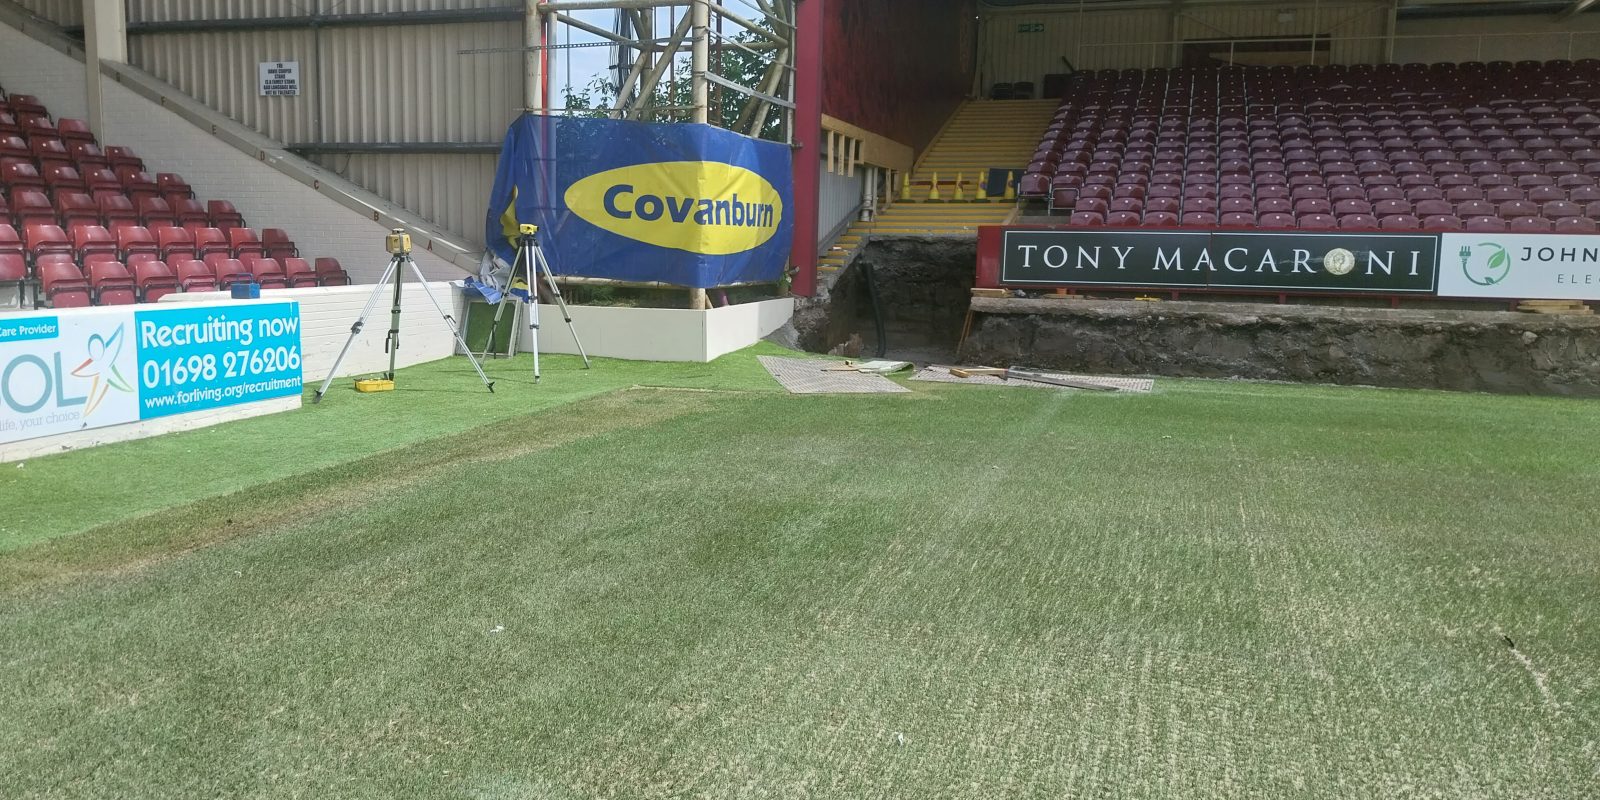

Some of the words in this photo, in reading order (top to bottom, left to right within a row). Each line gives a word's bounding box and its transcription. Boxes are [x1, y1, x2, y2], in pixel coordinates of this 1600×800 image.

[260, 150, 265, 161] D
[313, 180, 320, 190] C
[603, 184, 773, 228] Covanburn
[373, 211, 380, 221] B
[427, 240, 433, 251] A
[1017, 245, 1134, 270] TONY
[1520, 247, 1598, 262] JOHN
[1557, 274, 1600, 284] ELE
[19, 324, 56, 335] Provider
[141, 315, 253, 349] Recruiting
[258, 316, 298, 338] now
[143, 354, 217, 389] 01698
[222, 346, 300, 378] 276206
[0, 351, 88, 414] OL
[145, 376, 301, 408] www.forliving.org/recruitment
[20, 416, 43, 430] your
[45, 411, 80, 424] choice
